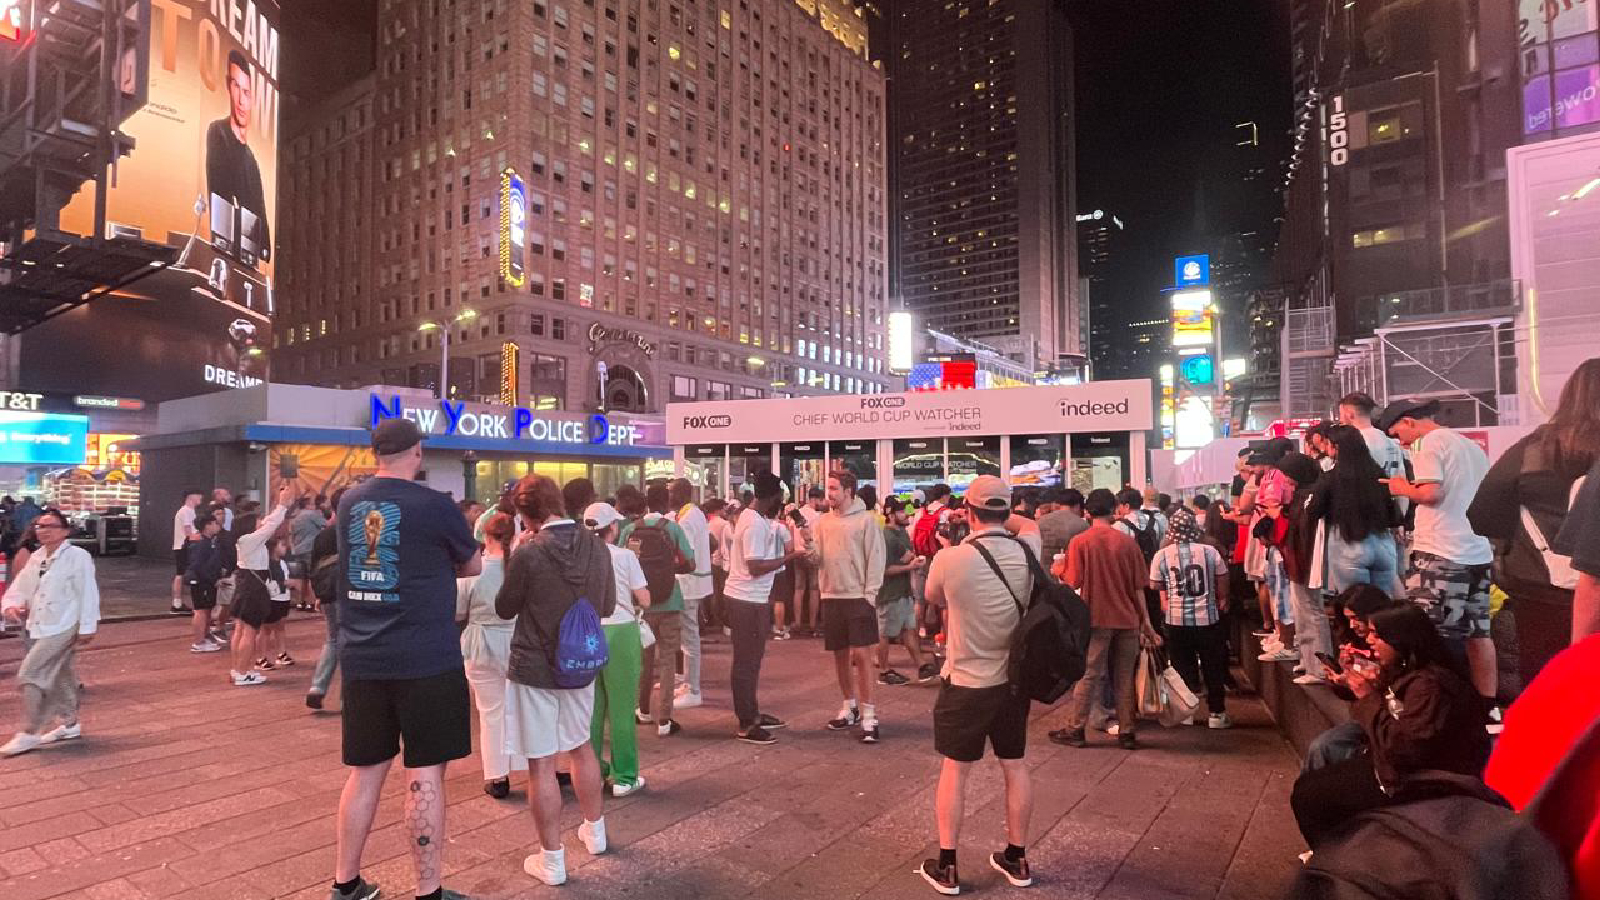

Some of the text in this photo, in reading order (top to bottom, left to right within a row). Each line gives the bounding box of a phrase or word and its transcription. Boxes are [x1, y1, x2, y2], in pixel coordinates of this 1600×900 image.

[1330, 95, 1348, 166] 1500
[861, 398, 884, 409] FOX
[1059, 398, 1128, 417] indeed
[370, 393, 636, 446] NEW YORK POLICE DEPT
[683, 415, 731, 429] FOX ONE
[793, 407, 981, 425] CHIEF WORLD CUP WATCHER
[948, 422, 981, 432] indeed
[361, 570, 385, 582] FIFA
[1170, 563, 1206, 597] 10
